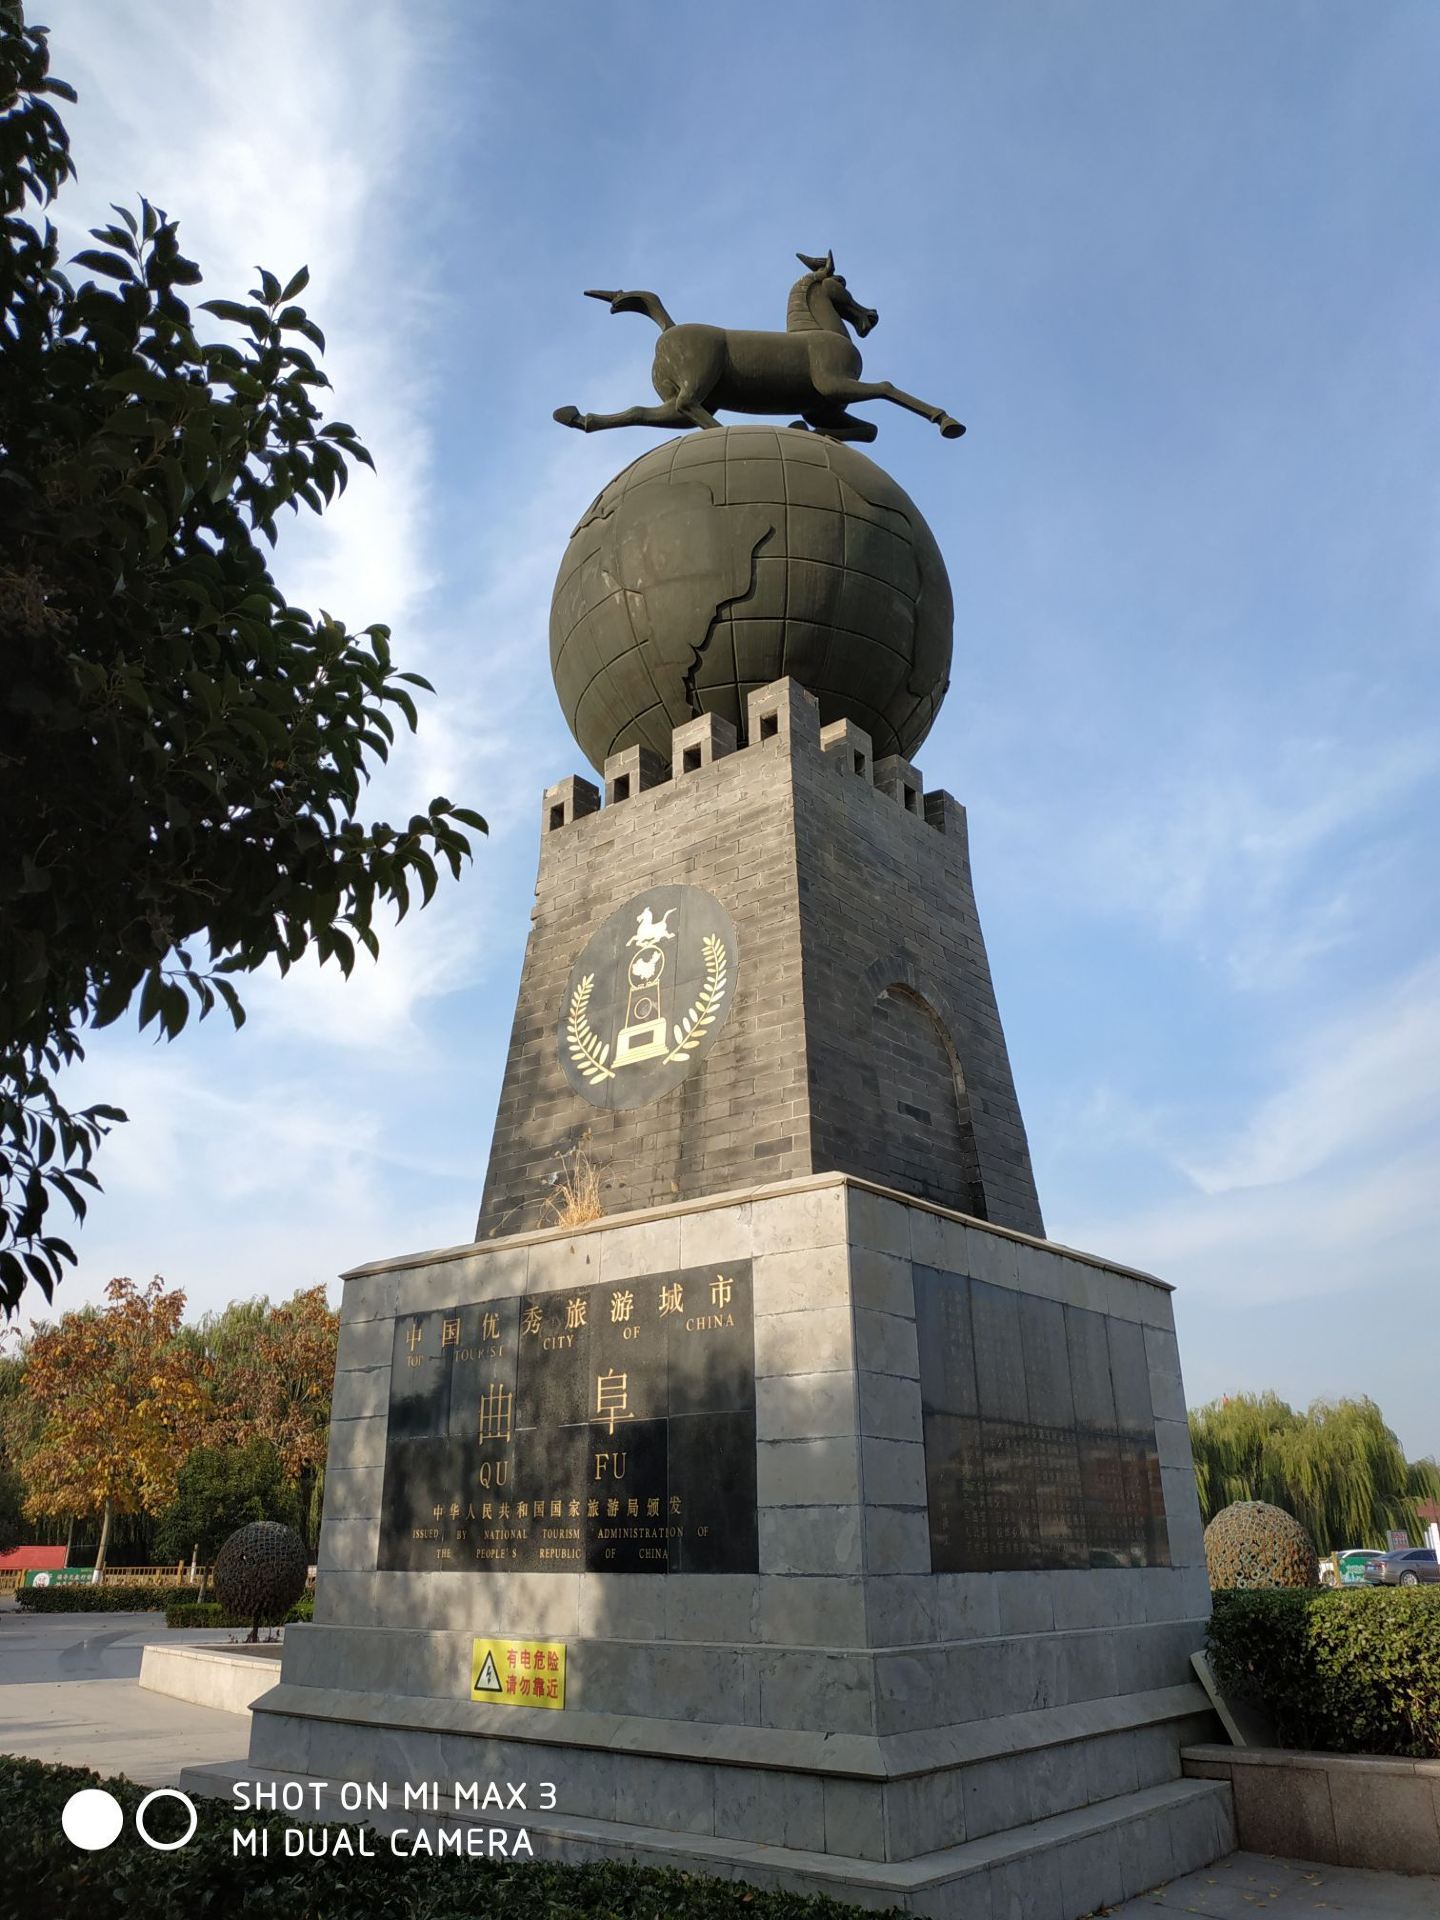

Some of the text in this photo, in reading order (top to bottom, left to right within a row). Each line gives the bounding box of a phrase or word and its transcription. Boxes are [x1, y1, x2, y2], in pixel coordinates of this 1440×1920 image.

[406, 1274, 734, 1352] 中国优秀旅游城市
[455, 1345, 504, 1362] TOURIST
[543, 1335, 575, 1351] CITY
[623, 1325, 641, 1340] OF
[686, 1313, 735, 1332] CHINA
[479, 1368, 635, 1445] 曲阜
[479, 1451, 628, 1490] QU FU
[433, 1496, 682, 1520] 中华人民共和国国家旅游局颁发
[412, 1526, 709, 1540] ISSUED BY NATIONAL TOURISM ADMINISTRATION OF
[436, 1548, 451, 1559] THE
[539, 1548, 581, 1559] REPUBLIC
[604, 1548, 616, 1559] OF
[638, 1548, 668, 1559] CHINA
[507, 1649, 559, 1671] 有电危险
[506, 1675, 559, 1698] 请勿靠近
